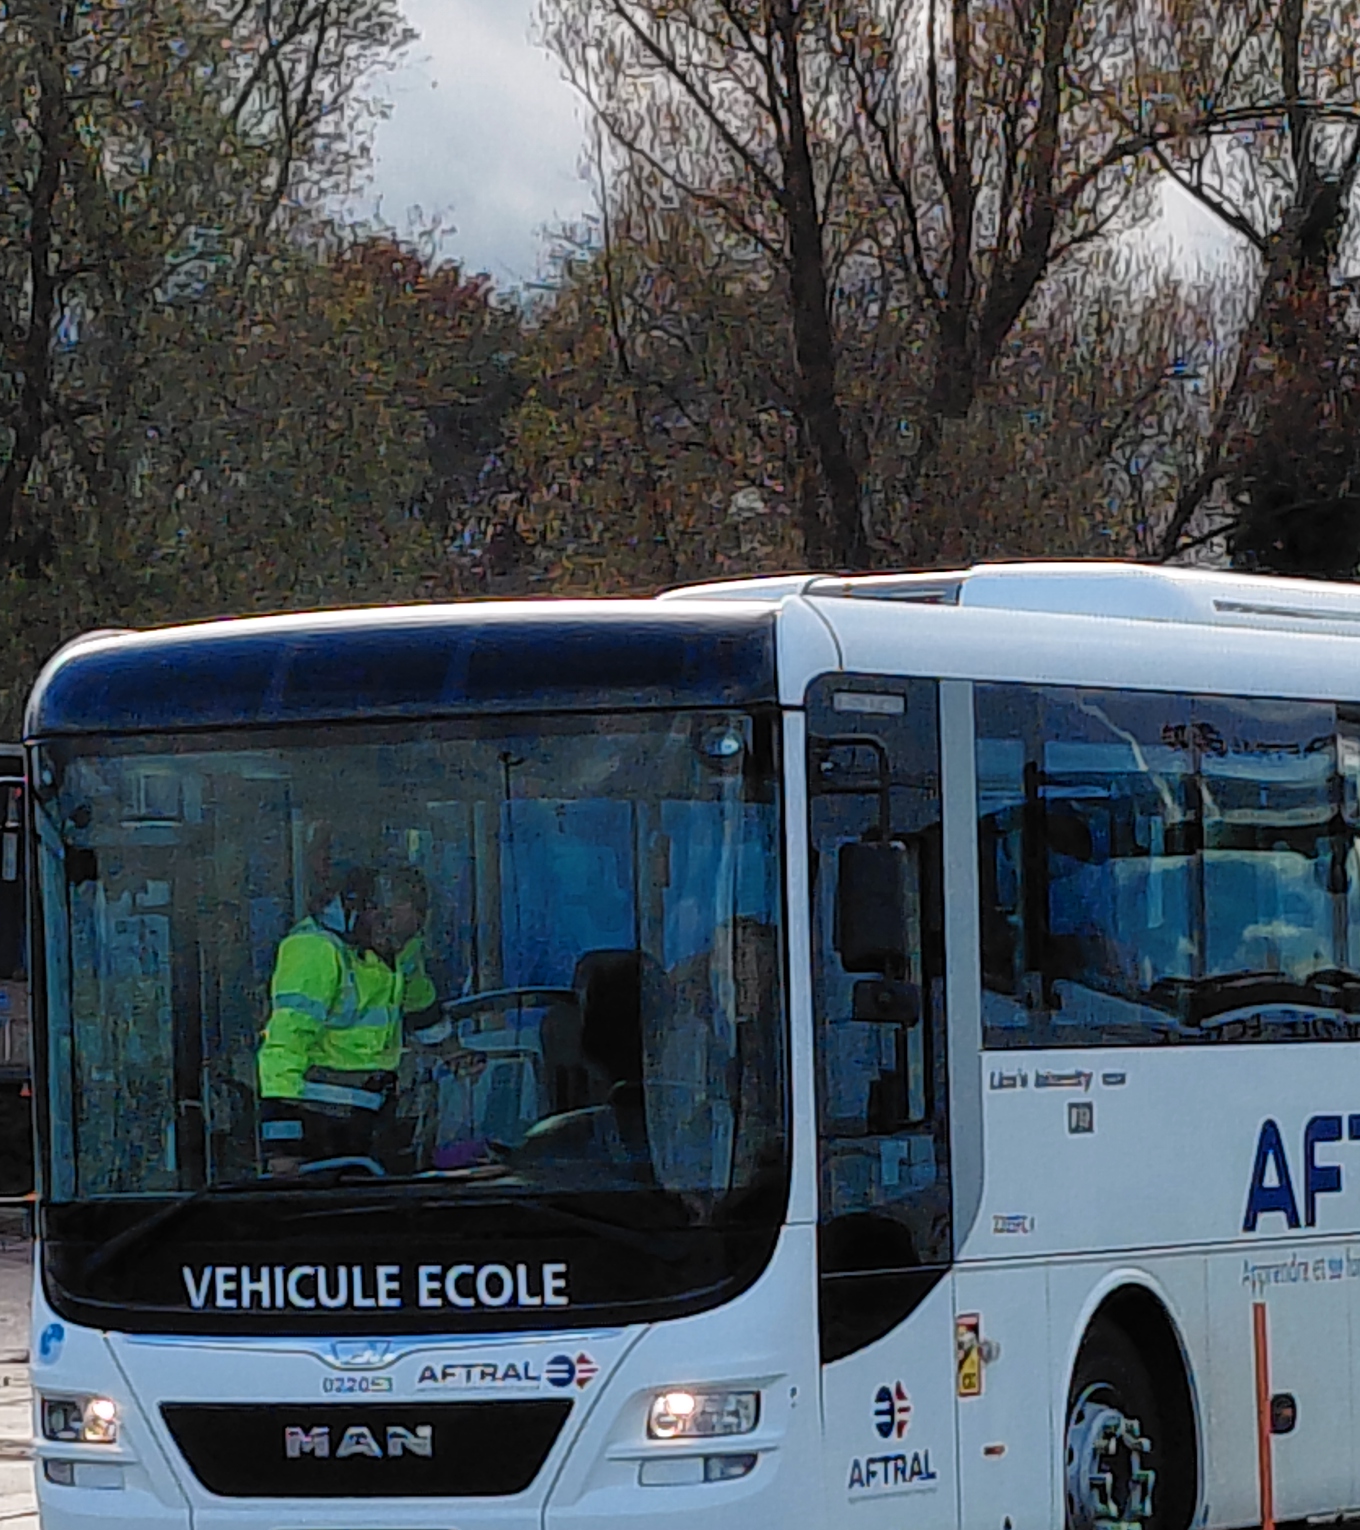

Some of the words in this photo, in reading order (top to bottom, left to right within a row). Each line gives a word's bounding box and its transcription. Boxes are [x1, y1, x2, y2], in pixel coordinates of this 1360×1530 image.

[182, 1264, 402, 1309] VEHICULE
[418, 1262, 569, 1307] ECOLE
[418, 1361, 540, 1384] AFTRAL
[285, 1424, 433, 1458] MAN
[848, 1448, 938, 1490] AFTRAL
